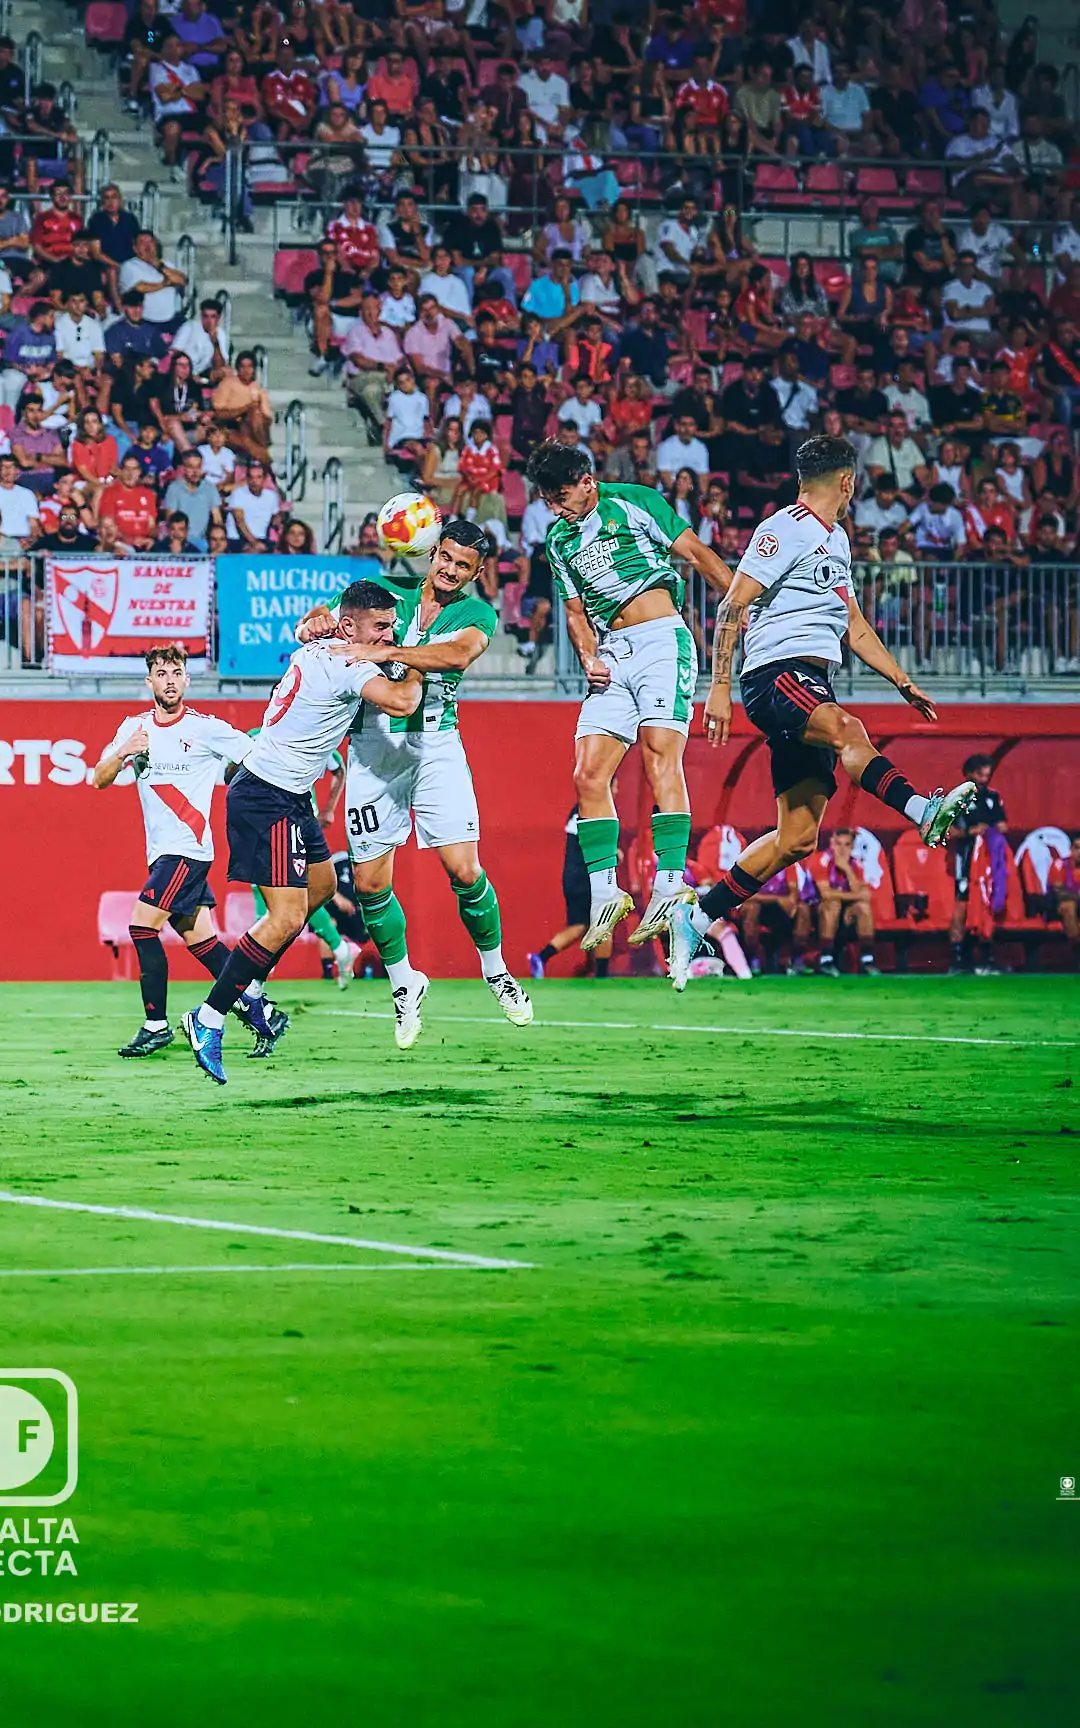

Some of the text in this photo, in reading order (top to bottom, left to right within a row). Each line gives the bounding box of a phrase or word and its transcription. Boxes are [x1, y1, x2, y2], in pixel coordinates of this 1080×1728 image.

[133, 565, 195, 578] SANGRE
[578, 552, 613, 578] GREEN
[246, 567, 351, 593] MUCHOS
[153, 582, 173, 594] DE
[128, 598, 196, 611] NUESTRA
[132, 615, 193, 627] SANGRE
[239, 622, 271, 646] EN
[154, 763, 190, 772] SEVILLA FC
[348, 804, 380, 836] 30
